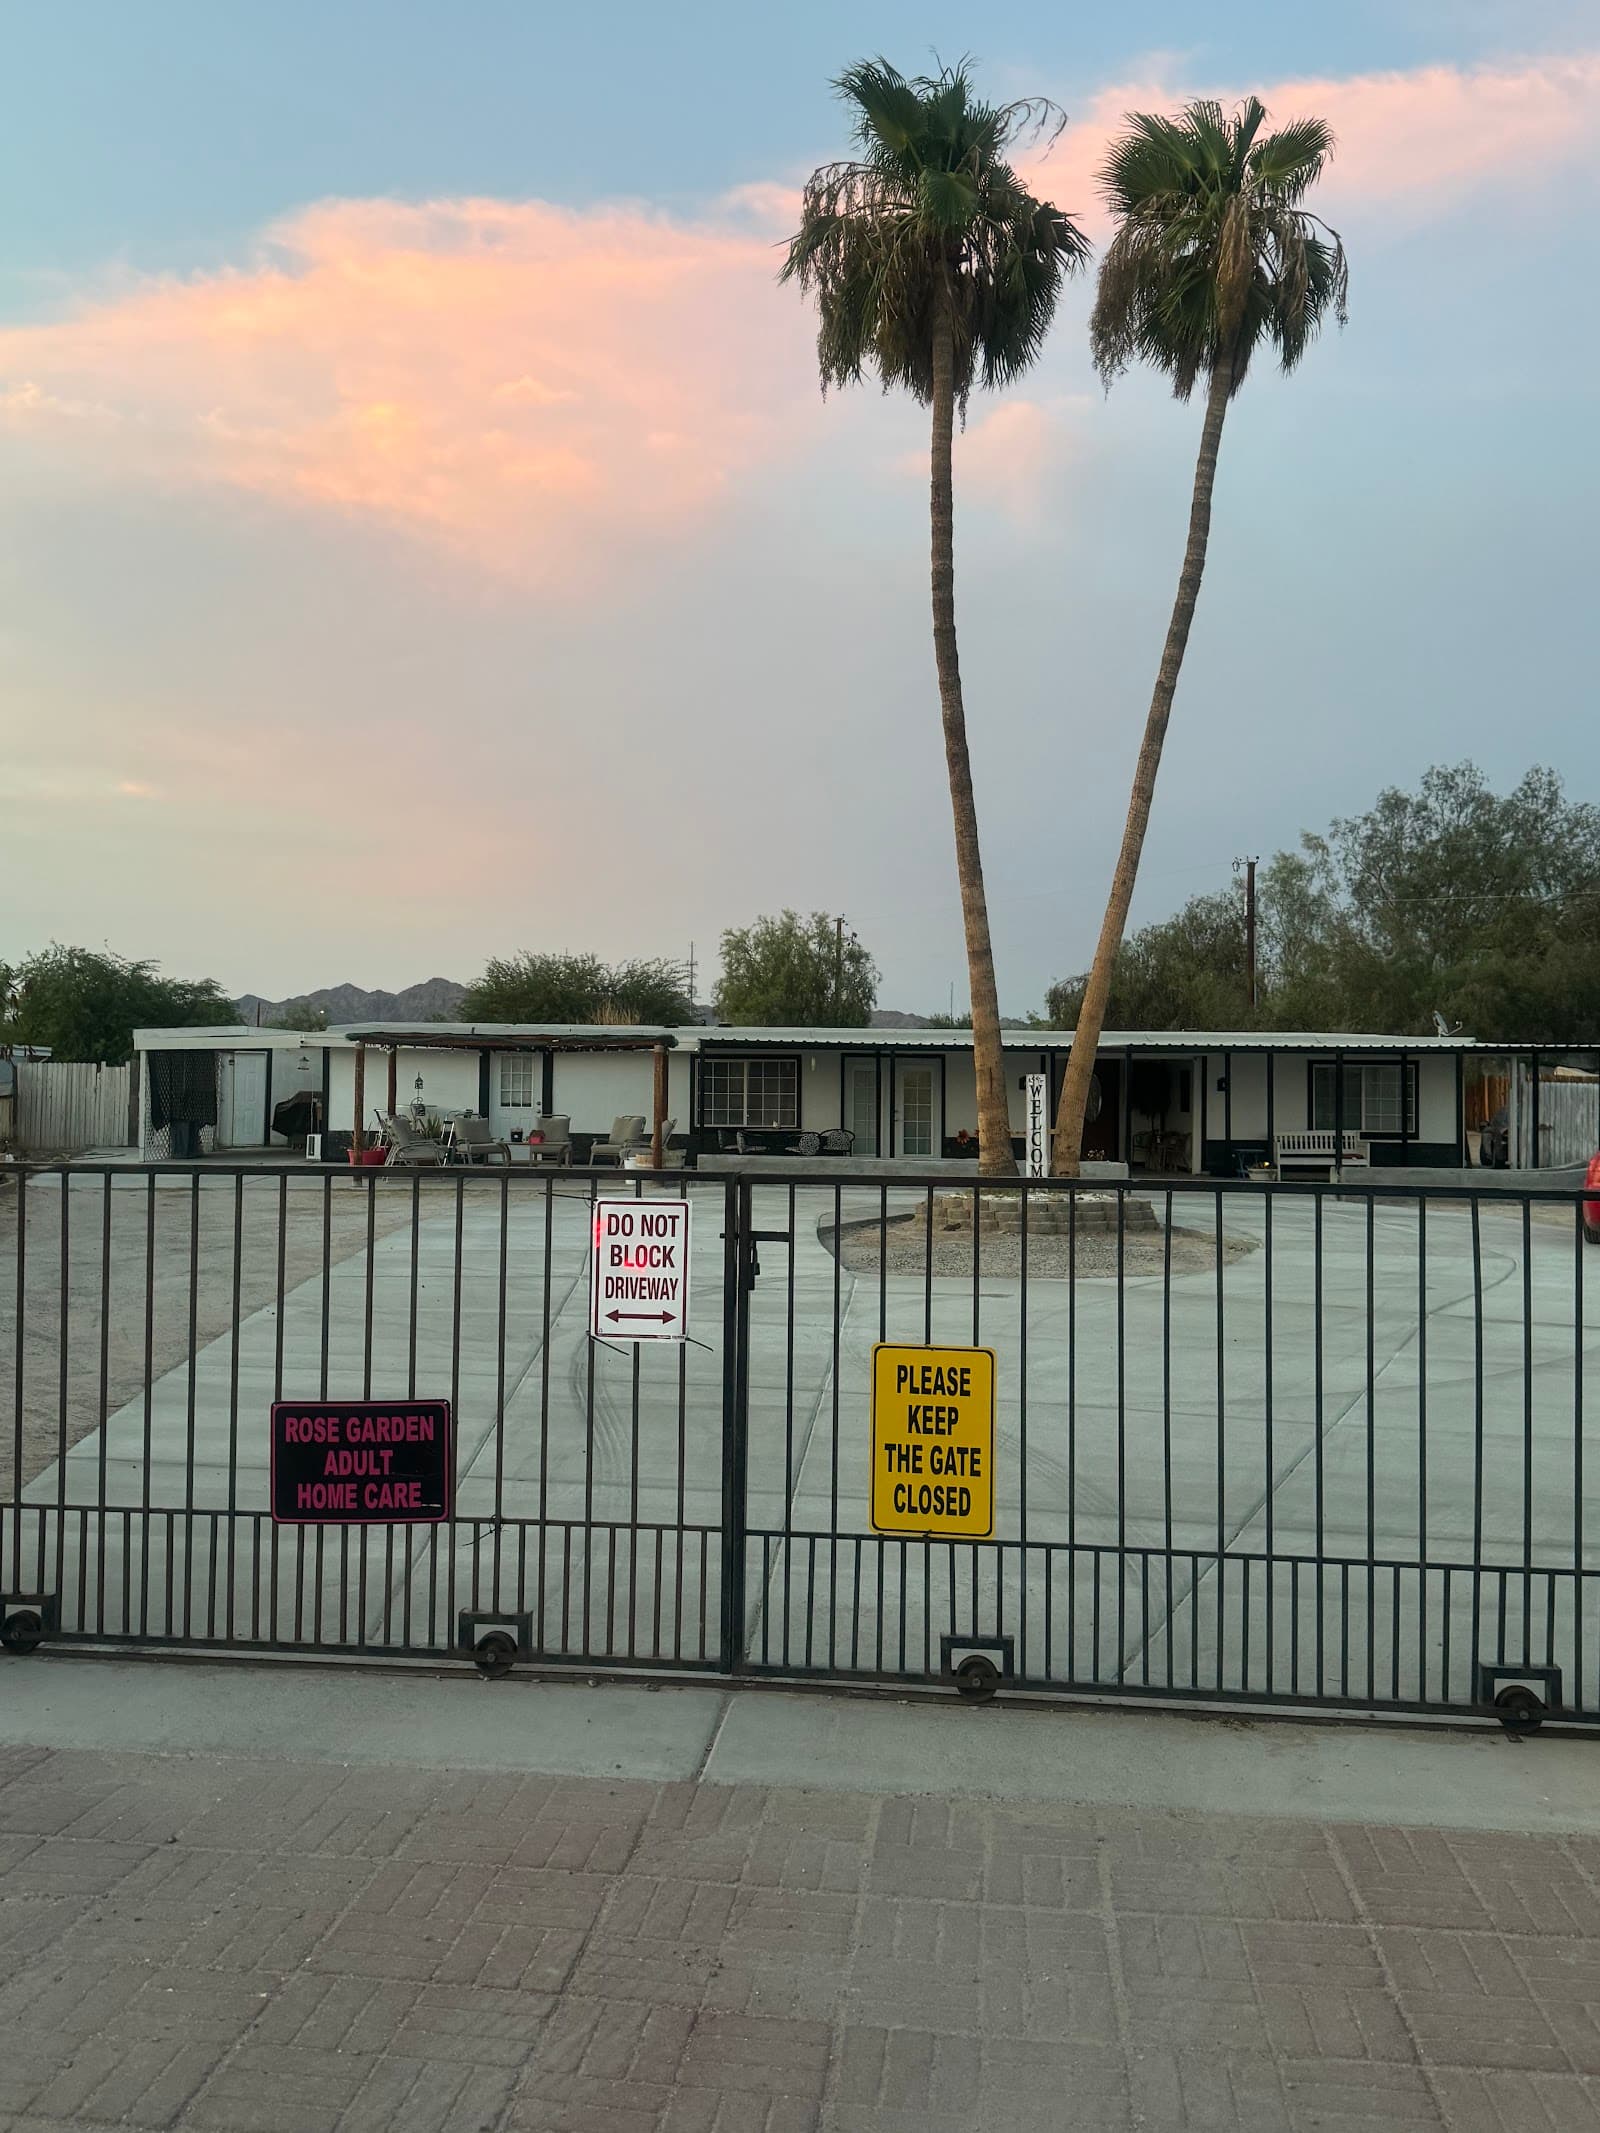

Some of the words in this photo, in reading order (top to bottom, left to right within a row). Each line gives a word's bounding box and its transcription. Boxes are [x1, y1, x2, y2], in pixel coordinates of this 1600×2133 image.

[1030, 1084, 1043, 1179] WELCOM
[607, 1213, 634, 1236] DO
[640, 1214, 680, 1237] NOT
[610, 1244, 676, 1268] BLOCK
[605, 1276, 679, 1301] DRIVEWAY
[897, 1364, 971, 1397] PLEASE
[285, 1417, 341, 1443] ROSE
[346, 1415, 434, 1443] GARDEN
[907, 1404, 959, 1436] KEEP
[323, 1450, 394, 1476] ADULT
[884, 1443, 923, 1474] THE
[929, 1445, 982, 1477] GATE
[297, 1483, 358, 1509] HOME
[364, 1482, 422, 1509] CARE
[893, 1483, 971, 1517] CLOSED
